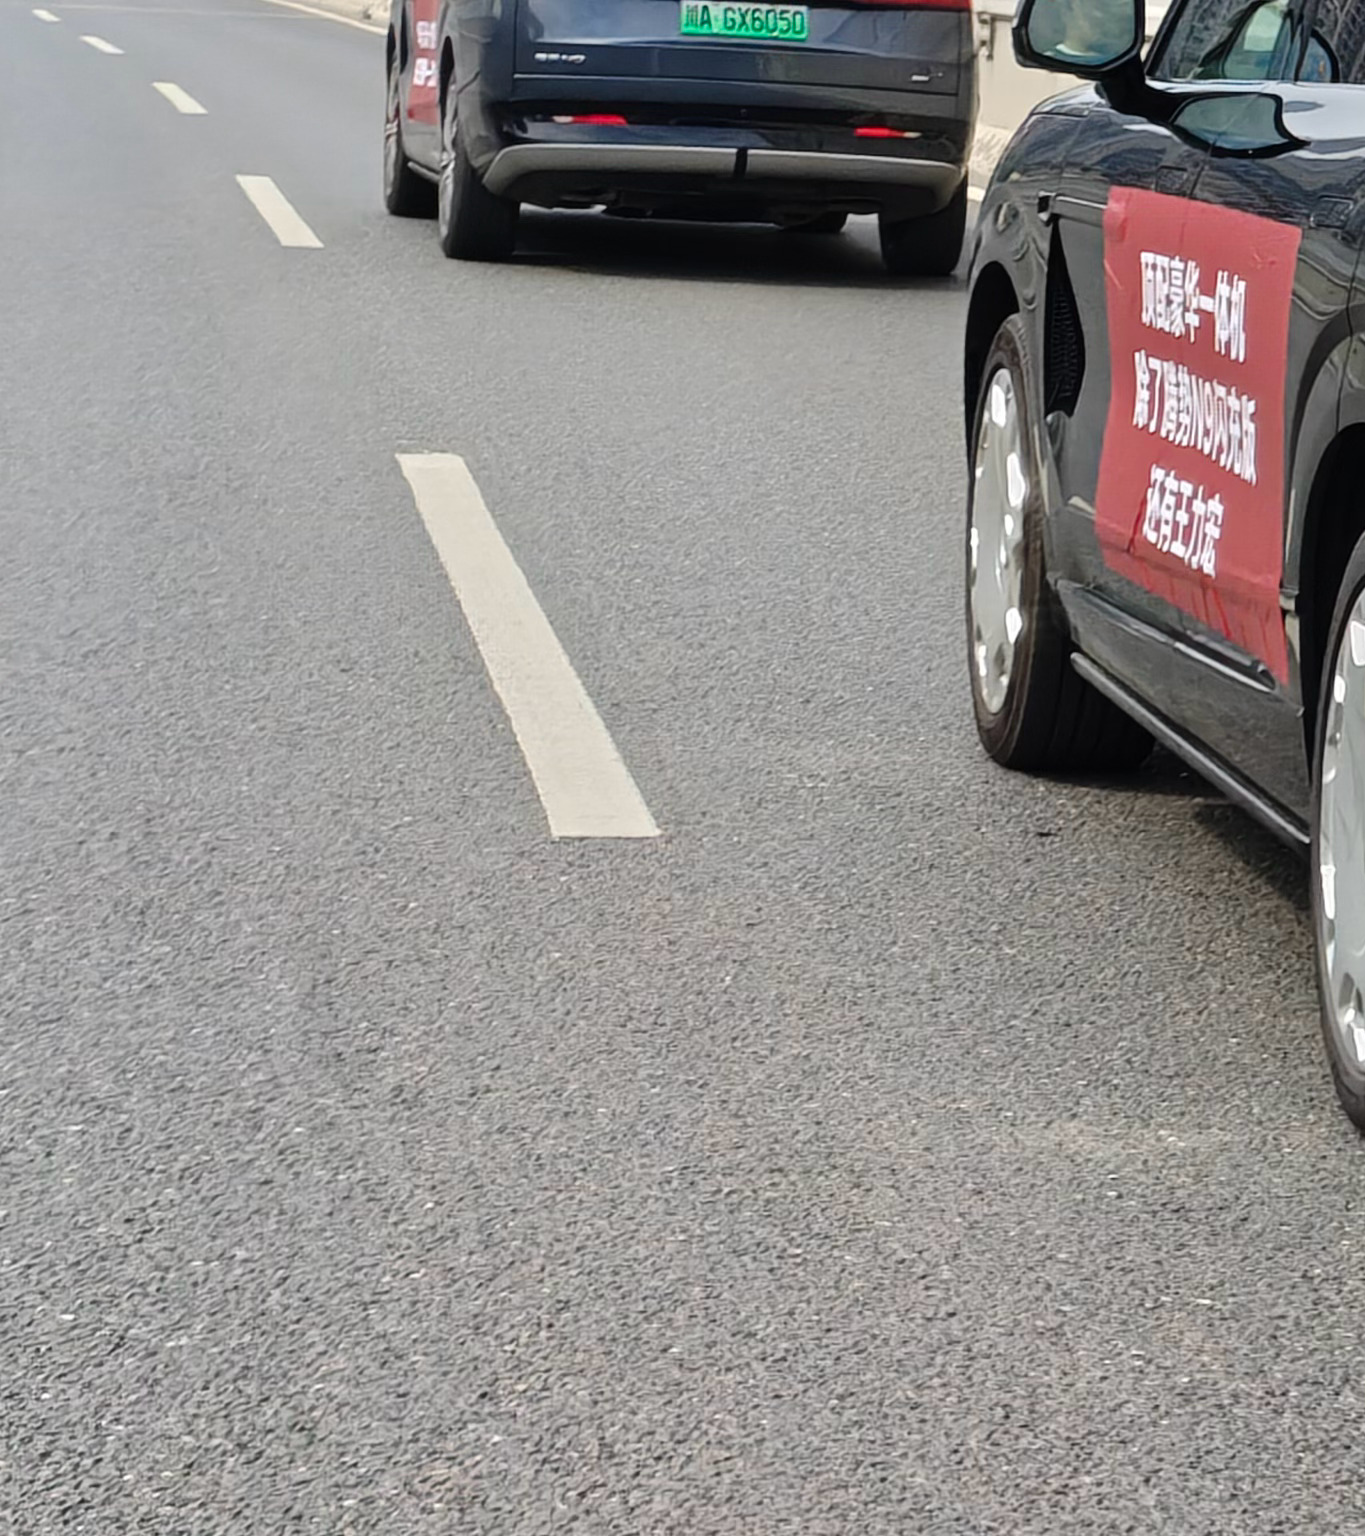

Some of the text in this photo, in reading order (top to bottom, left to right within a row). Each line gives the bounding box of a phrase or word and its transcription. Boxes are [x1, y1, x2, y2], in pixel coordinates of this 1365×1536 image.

[1139, 250, 1248, 363] 顶配豪华一体机
[1142, 463, 1226, 579] 还有王力宏
